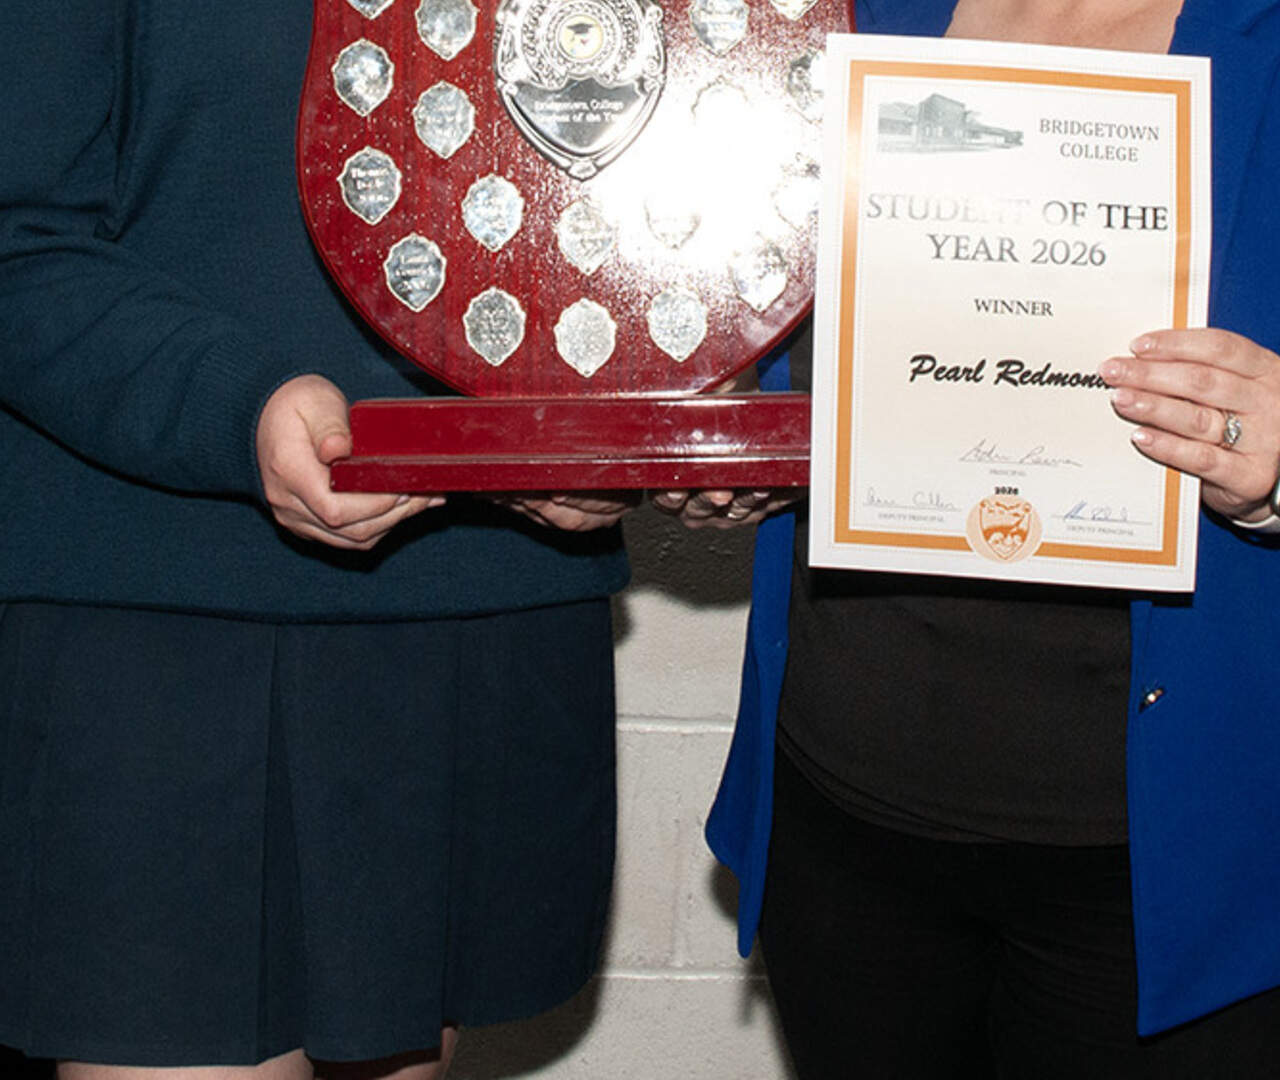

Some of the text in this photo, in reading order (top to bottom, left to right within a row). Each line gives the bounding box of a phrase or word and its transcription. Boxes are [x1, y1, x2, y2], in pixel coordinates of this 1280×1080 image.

[1039, 118, 1160, 141] BRIDGETOWN
[1059, 142, 1139, 162] COLLEGE
[865, 192, 1169, 231] STUDET OF THE
[926, 233, 1107, 267] YEAR 2026
[973, 298, 1054, 317] WINNER
[908, 353, 987, 383] Pearl
